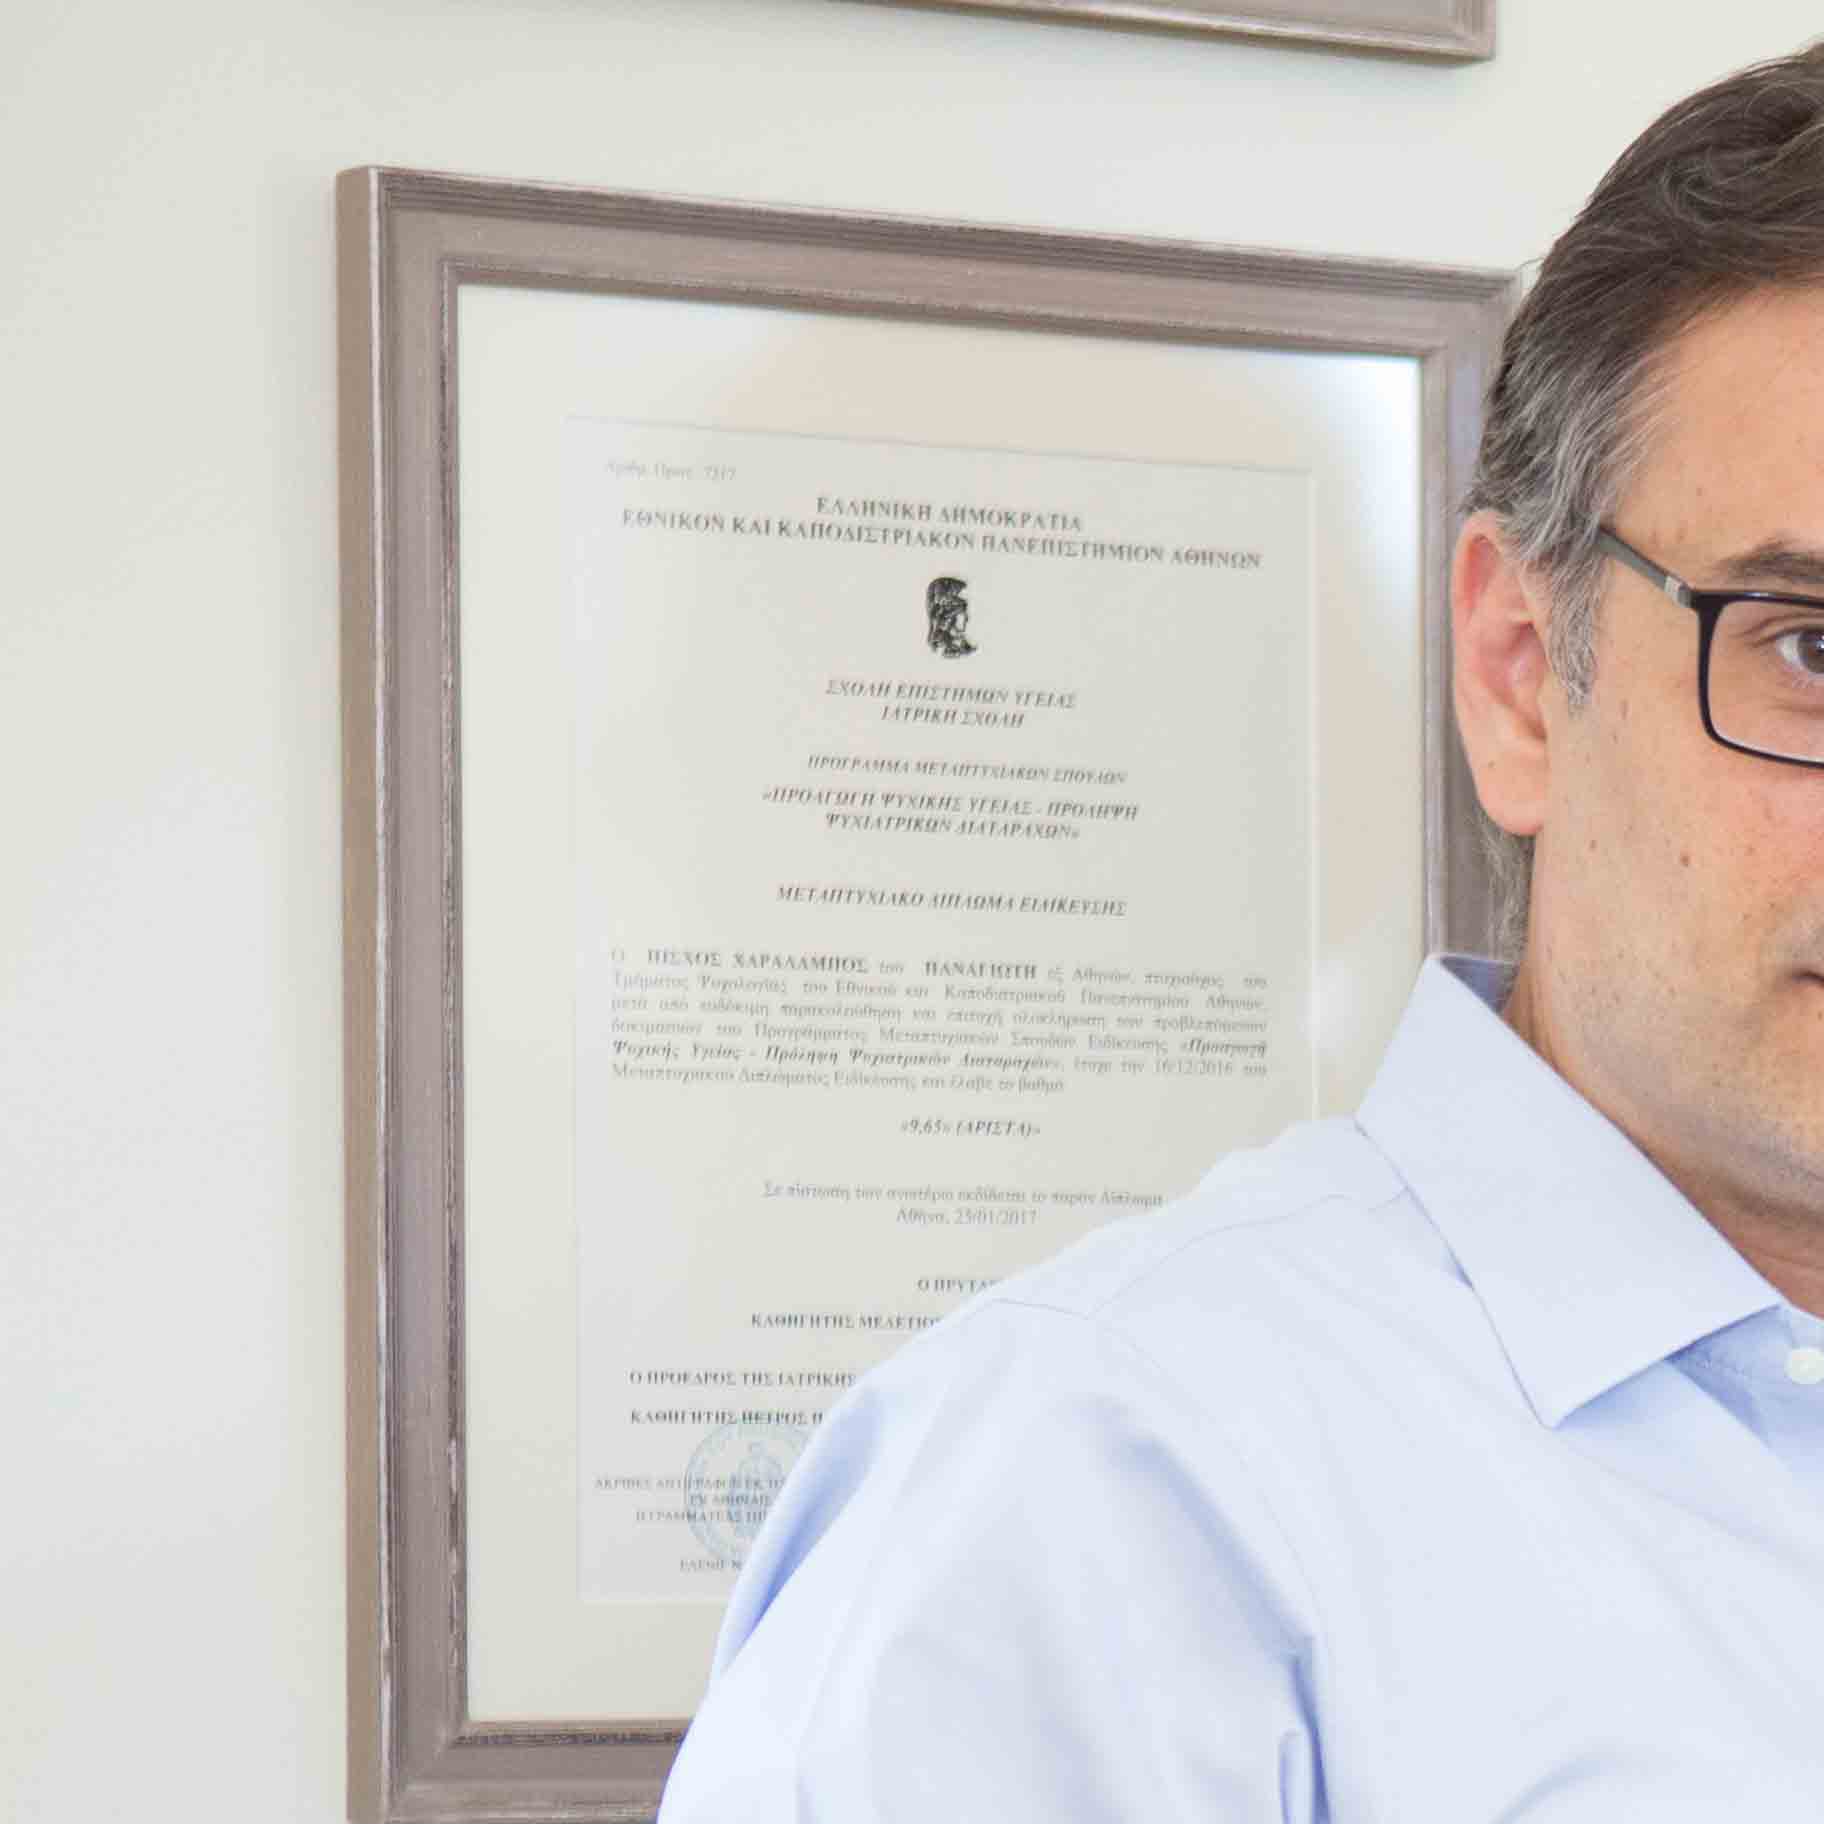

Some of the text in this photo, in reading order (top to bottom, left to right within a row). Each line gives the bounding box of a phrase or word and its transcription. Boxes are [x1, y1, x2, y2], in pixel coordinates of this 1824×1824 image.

[817, 496, 1081, 531] ΕΛΛΗΝΙΚΗ ΔΗΜΟΚΡΑΤΙΑ
[623, 509, 1260, 569] ΕΘΝΙΚΟΝ ΚΑΙ ΚΑΠΟΔΙΣΤΡΙΑΚΟΝ ΠΑΝΕΠΙΣΤΗΜΙΟΝ ΑΘΗΝΩΝ
[826, 679, 1077, 709] ΣΧΟΛΗ ΕΠΙΣΤΗΜΩΝ ΥΓΕΙΑΣ
[880, 705, 1025, 729] ΙΑΤΡΙΚΗ ΣΧΟΛΗ
[732, 952, 869, 974] ΧΑΡΑΛΑΜΠΟΣ
